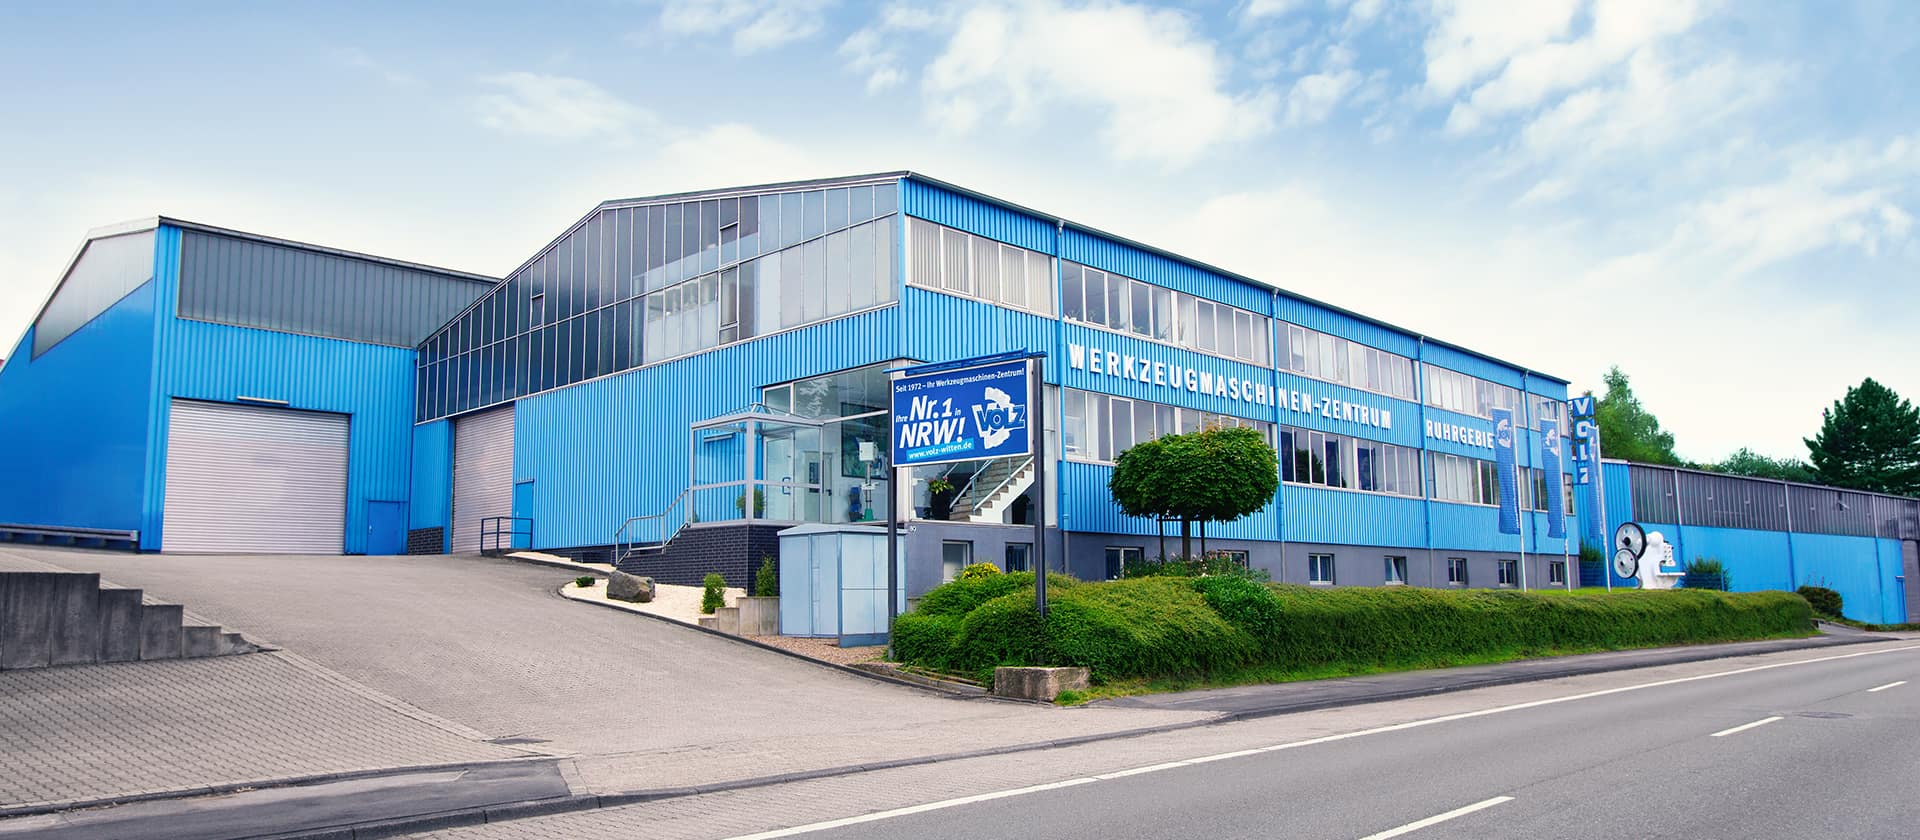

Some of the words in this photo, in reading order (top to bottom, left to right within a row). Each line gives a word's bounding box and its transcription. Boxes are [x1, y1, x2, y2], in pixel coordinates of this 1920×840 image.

[895, 384, 907, 393] Seit
[908, 382, 921, 392] 1972
[927, 381, 936, 389] Ihr
[936, 367, 1024, 388] Werkzeugmaschinen-Zentrum!
[1068, 343, 1391, 429] WERKZEUGMASCHINEN-ZENTRUM
[895, 414, 908, 423] Ihre
[909, 395, 939, 421] Nr.
[941, 397, 953, 418] 1
[954, 407, 962, 417] in
[971, 402, 1025, 438] VOLZ
[899, 416, 966, 449] NRW!
[1426, 419, 1494, 449] RUHRGEBIE
[908, 441, 973, 460] www.volz-witten.de
